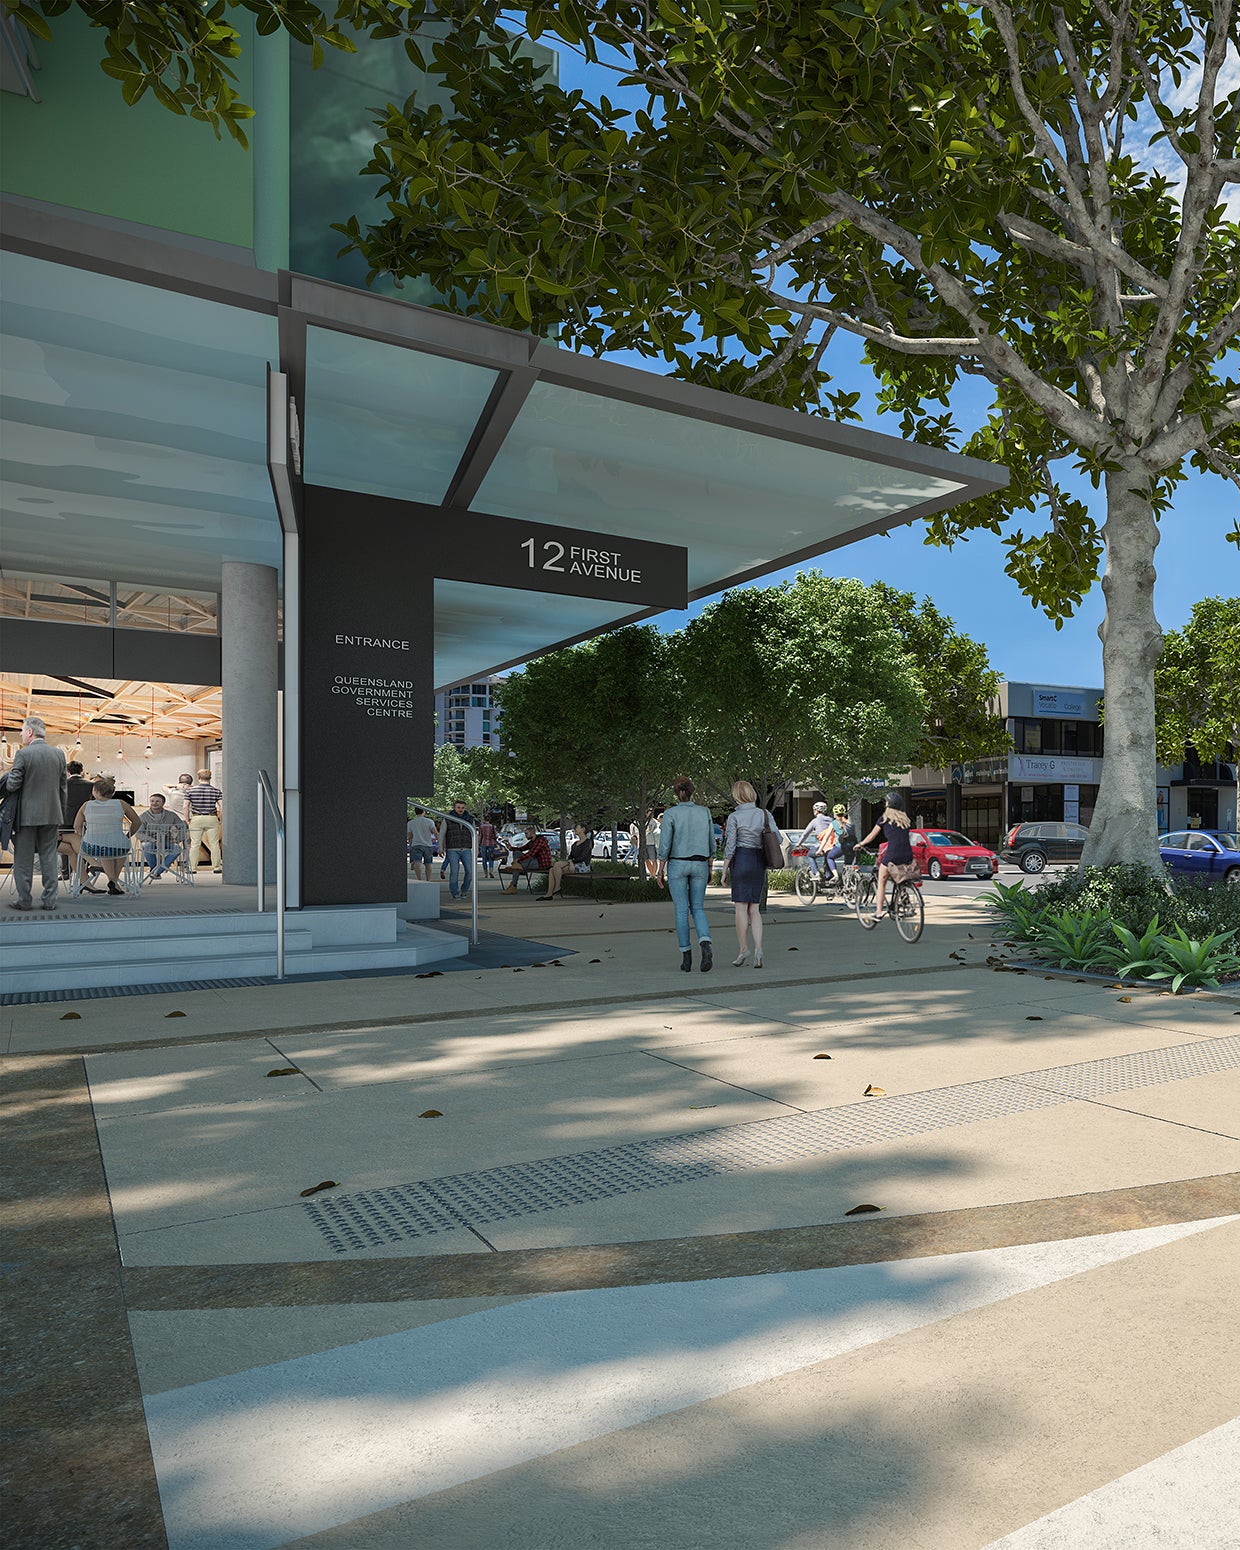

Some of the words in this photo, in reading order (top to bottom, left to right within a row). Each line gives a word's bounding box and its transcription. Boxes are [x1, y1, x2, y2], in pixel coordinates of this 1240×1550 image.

[520, 537, 565, 573] 12
[570, 546, 622, 566] FIRST
[569, 561, 642, 584] AVENUE
[335, 634, 410, 651] ENTRANCE
[334, 675, 414, 689] QUEENSLAND
[331, 685, 414, 699] GOVERNMENT
[355, 697, 414, 709] SERVICES
[366, 707, 413, 719] CENTRE
[1026, 759, 1049, 771] Tracey
[1049, 759, 1056, 770] G
